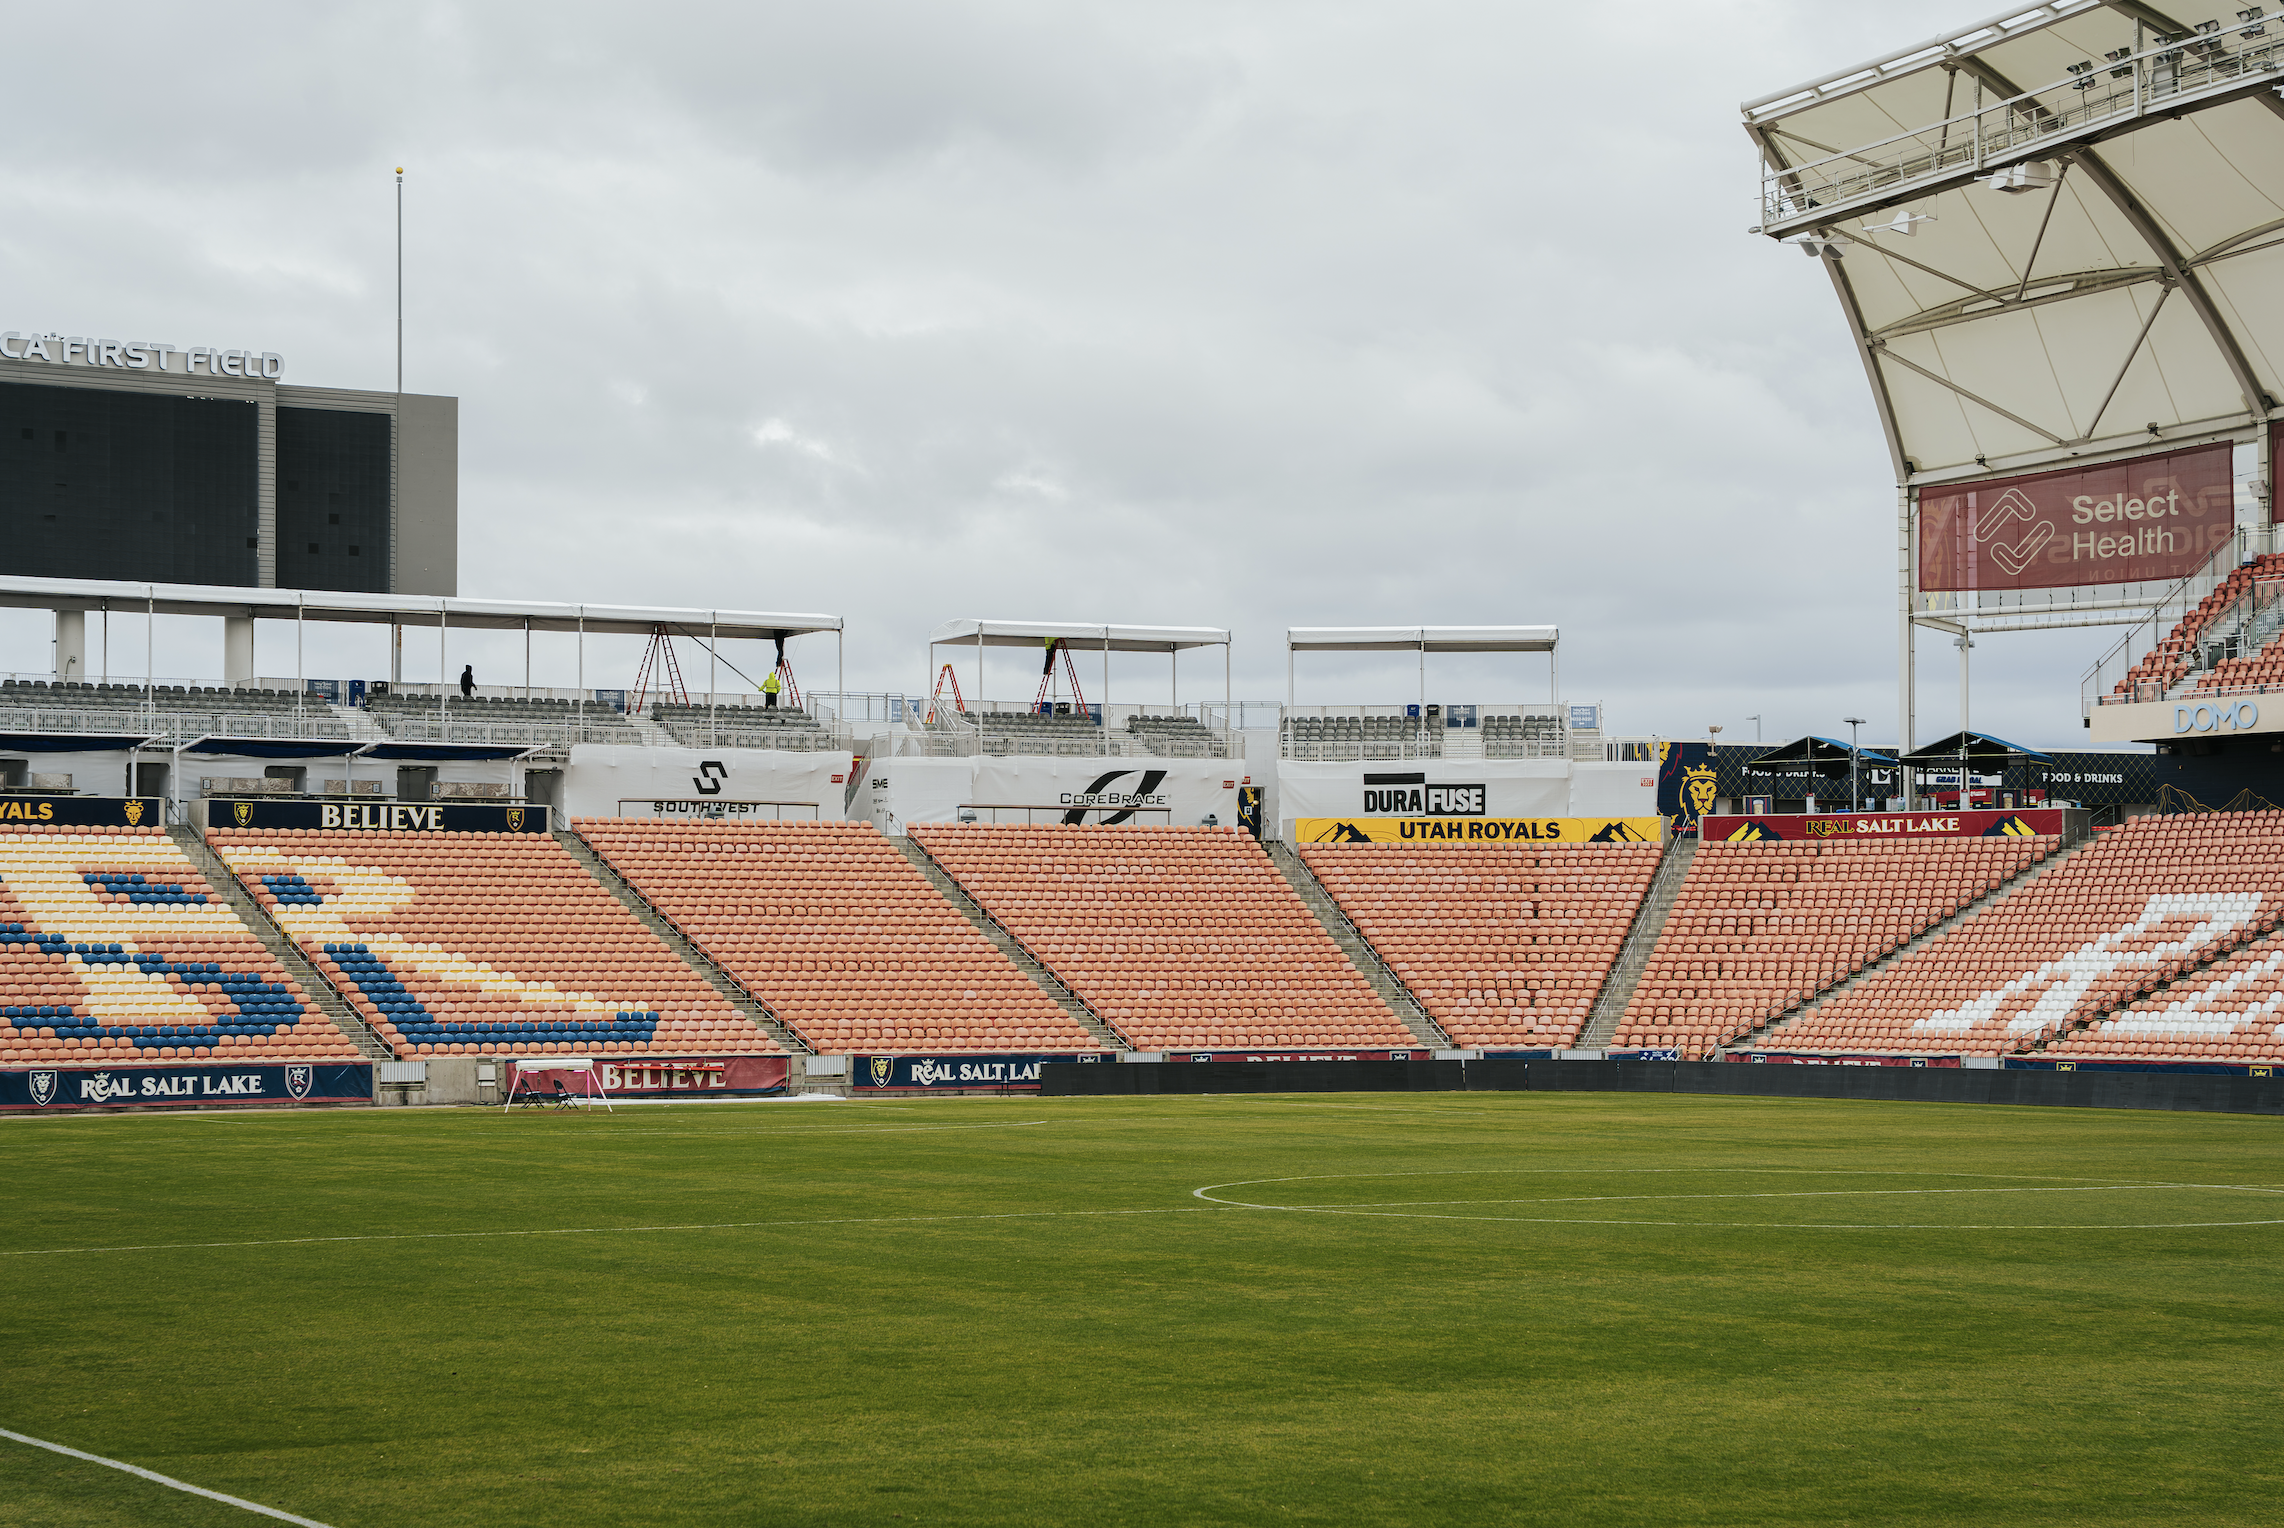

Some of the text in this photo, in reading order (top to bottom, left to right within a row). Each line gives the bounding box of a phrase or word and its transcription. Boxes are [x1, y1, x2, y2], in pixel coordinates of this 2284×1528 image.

[0, 331, 285, 379] CA FIRST FIELD
[2072, 489, 2179, 524] Select
[2073, 526, 2174, 560] Health
[2174, 700, 2258, 733] DOMO
[2042, 772, 2123, 783] FOOD & DRINKS
[1364, 788, 1482, 812] DURA FUSE
[321, 804, 444, 830] BELIEVE
[1806, 817, 1960, 837] REAL SALT LAKE
[1400, 822, 1560, 839] UTAH ROYALS
[602, 1062, 727, 1089] BELIEVE
[960, 1063, 1005, 1080] SALT
[141, 1076, 198, 1096] SALT
[202, 1075, 263, 1095] LAKE
